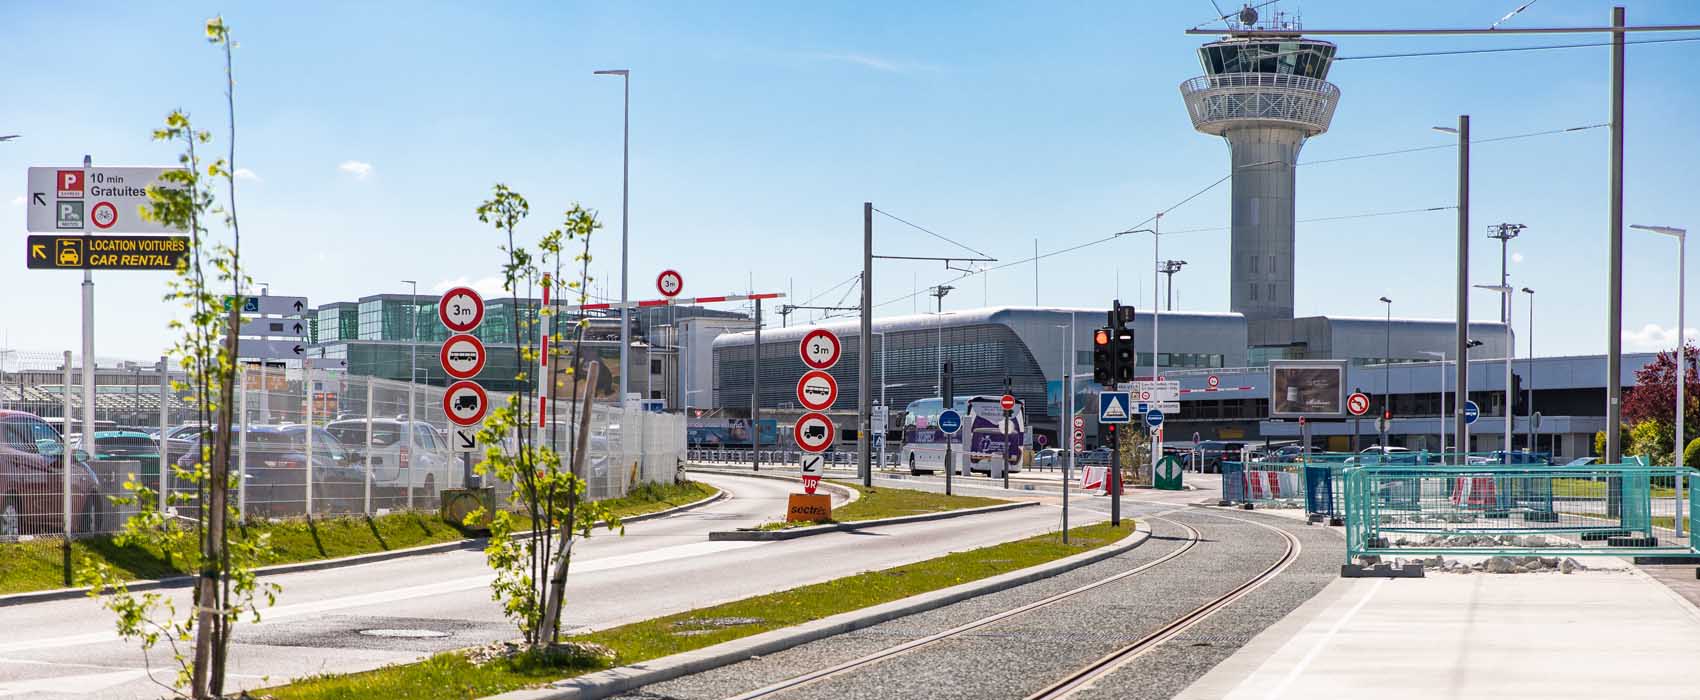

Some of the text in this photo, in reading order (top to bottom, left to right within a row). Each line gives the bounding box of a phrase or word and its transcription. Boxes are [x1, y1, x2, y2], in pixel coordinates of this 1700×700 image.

[64, 173, 77, 191] P
[90, 172, 124, 184] 10 min
[90, 185, 147, 197] Gratuites
[61, 204, 73, 220] P
[89, 239, 185, 252] LOCATION VOITURES
[89, 254, 172, 266] CAR RENTAL
